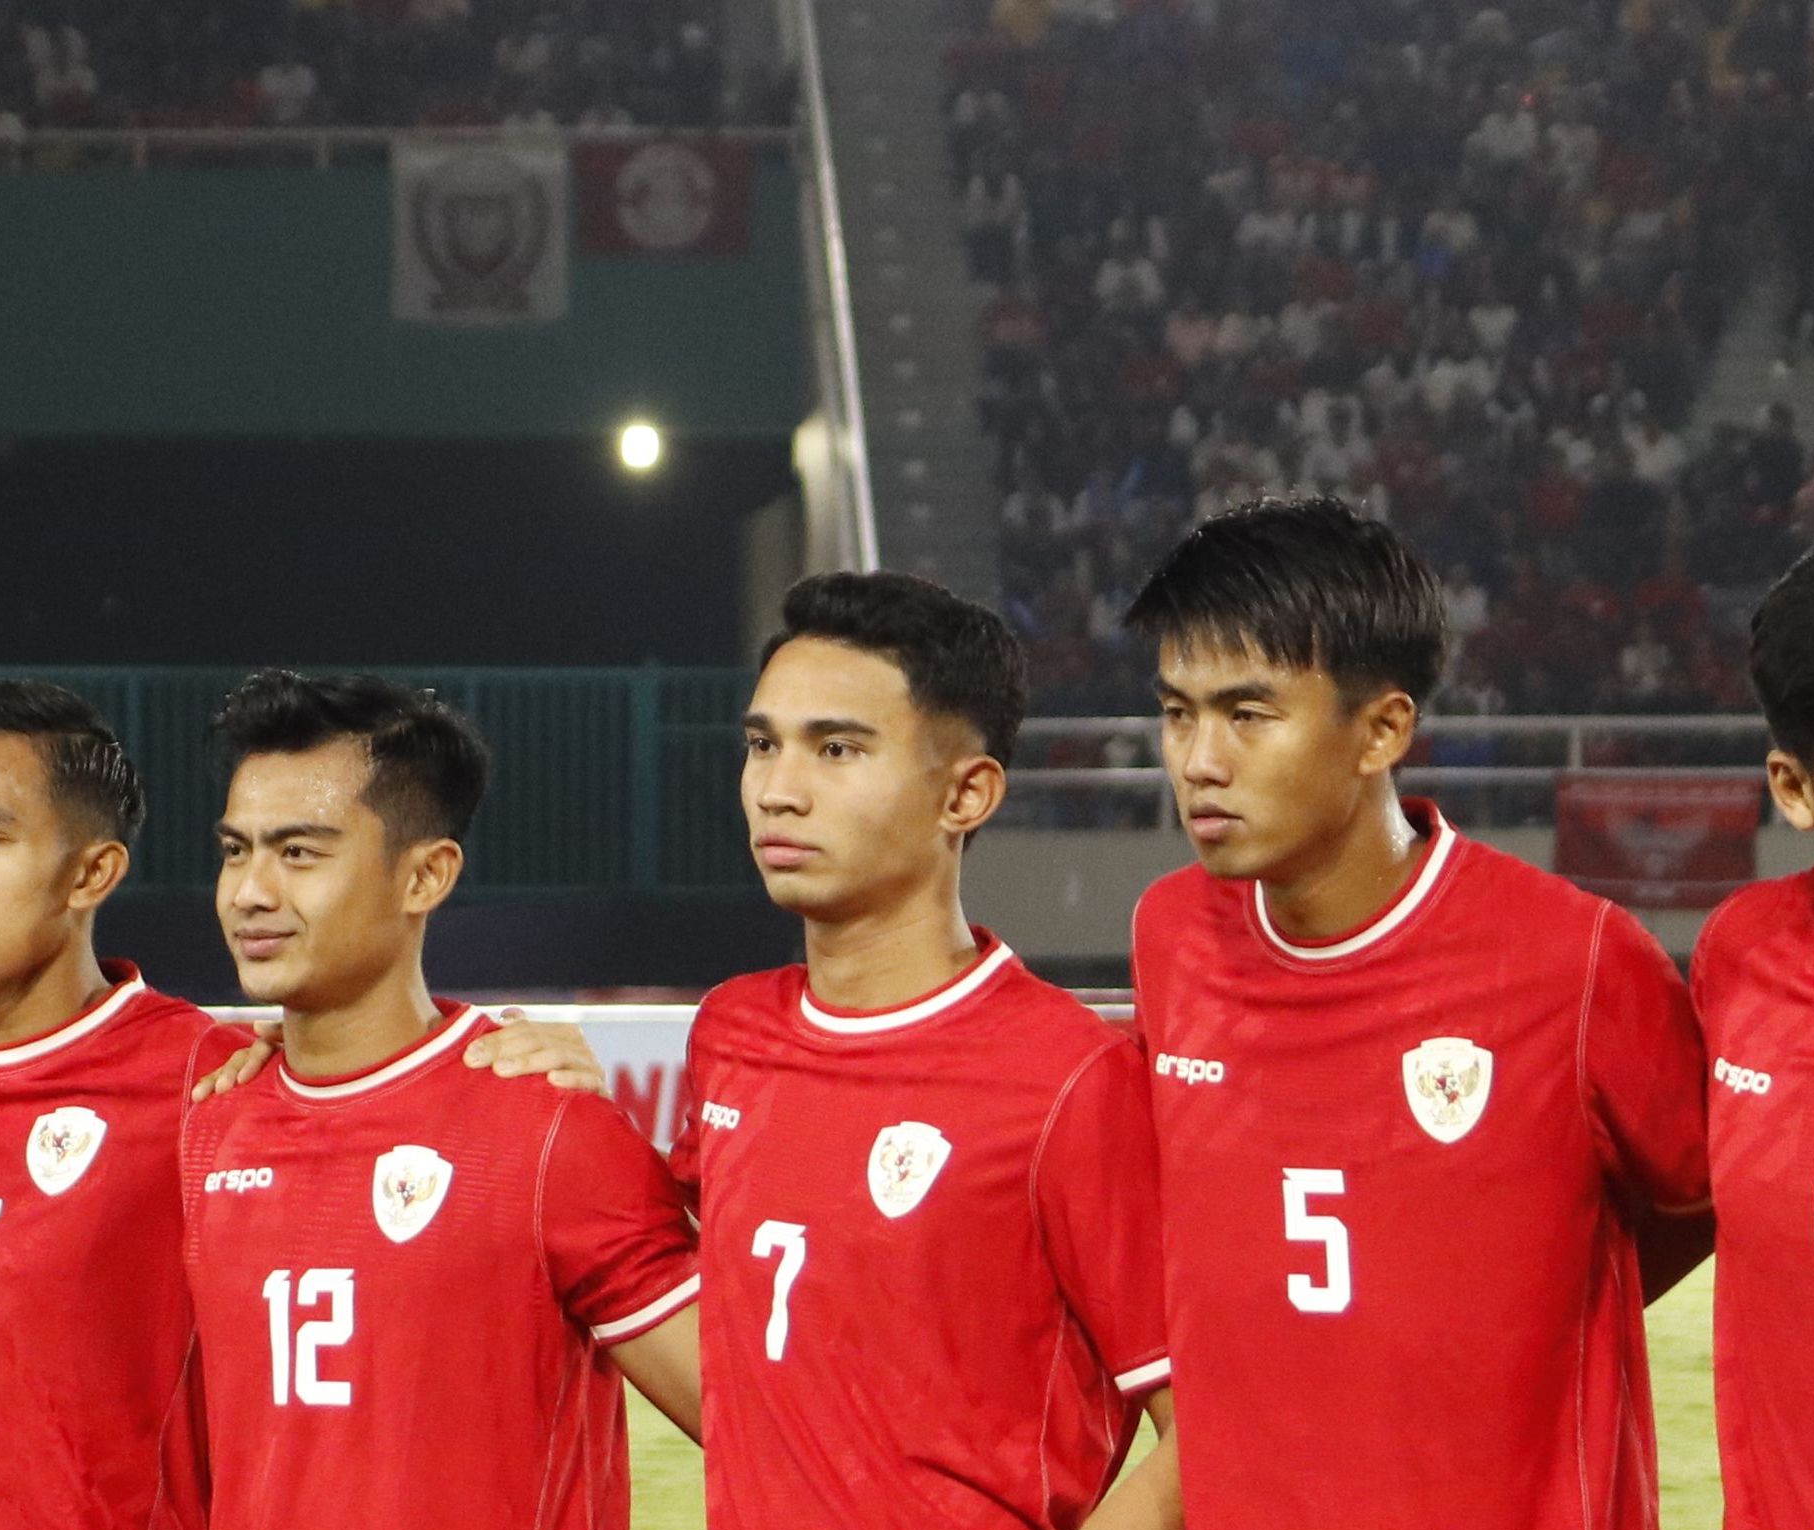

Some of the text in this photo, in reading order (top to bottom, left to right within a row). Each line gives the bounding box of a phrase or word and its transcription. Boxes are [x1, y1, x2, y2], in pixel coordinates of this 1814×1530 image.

[1155, 1052, 1225, 1086] erspo
[1714, 1056, 1772, 1096] erspo
[203, 1165, 275, 1195] erspo
[1282, 1167, 1352, 1314] 5
[751, 1219, 807, 1362] 7
[261, 1267, 356, 1407] 12
